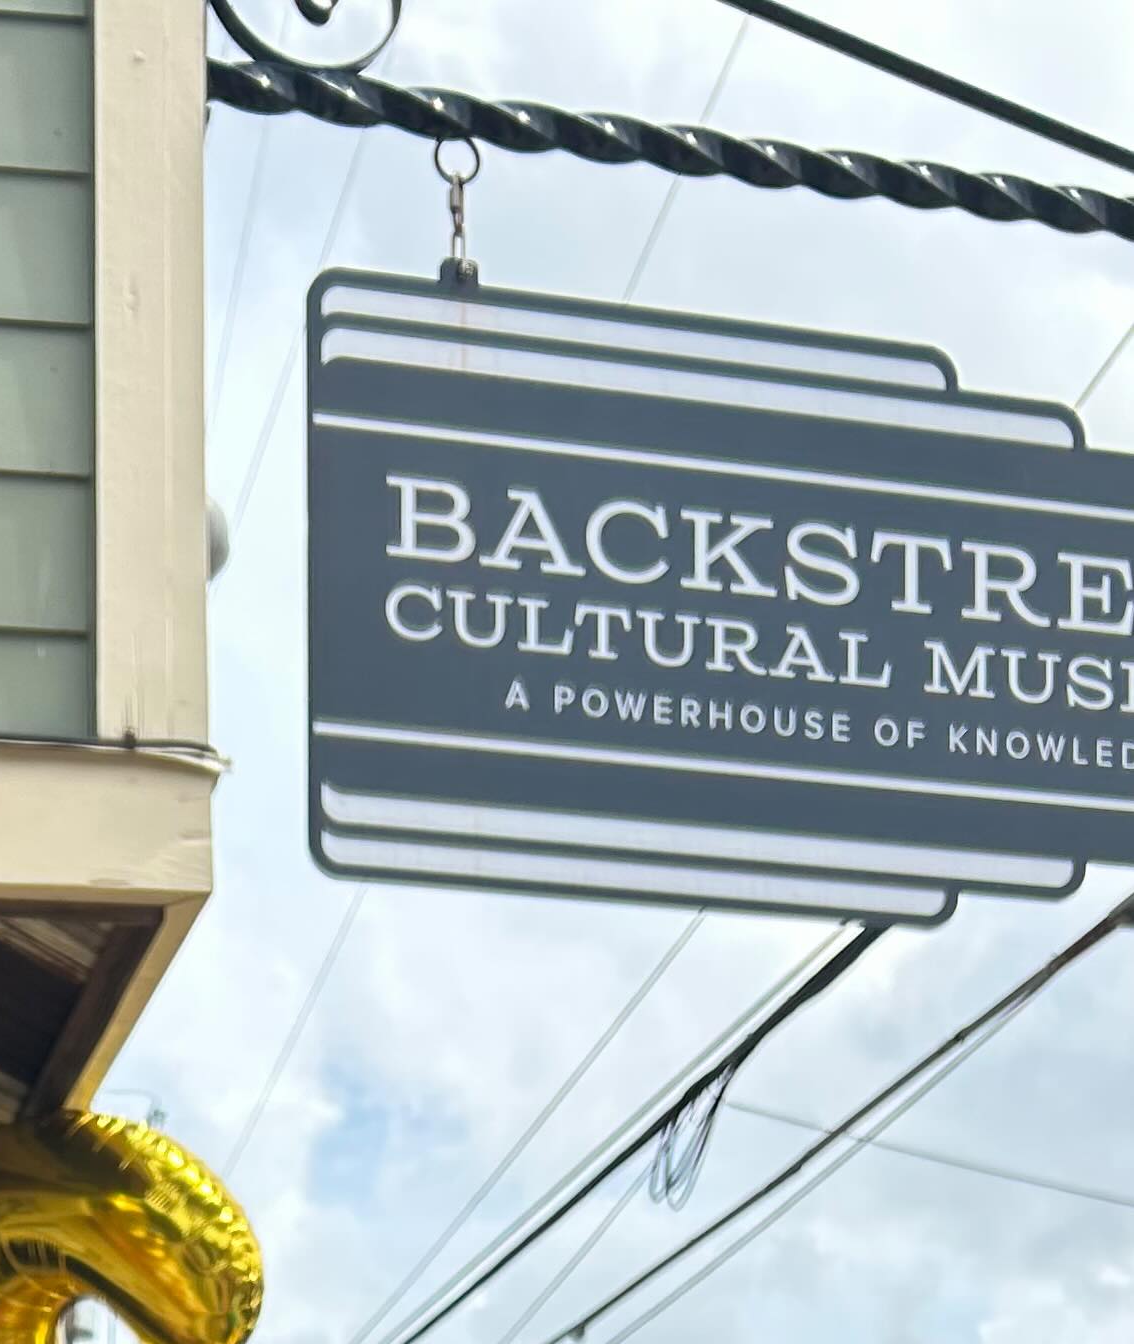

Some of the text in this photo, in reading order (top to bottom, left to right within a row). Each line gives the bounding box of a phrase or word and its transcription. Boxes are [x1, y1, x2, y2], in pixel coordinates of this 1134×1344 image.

[384, 472, 1134, 636] BACKSTRE
[384, 583, 892, 690] CULTURAL
[505, 680, 529, 712] A
[554, 684, 851, 742] POWERHOUSE
[874, 716, 926, 749] OF
